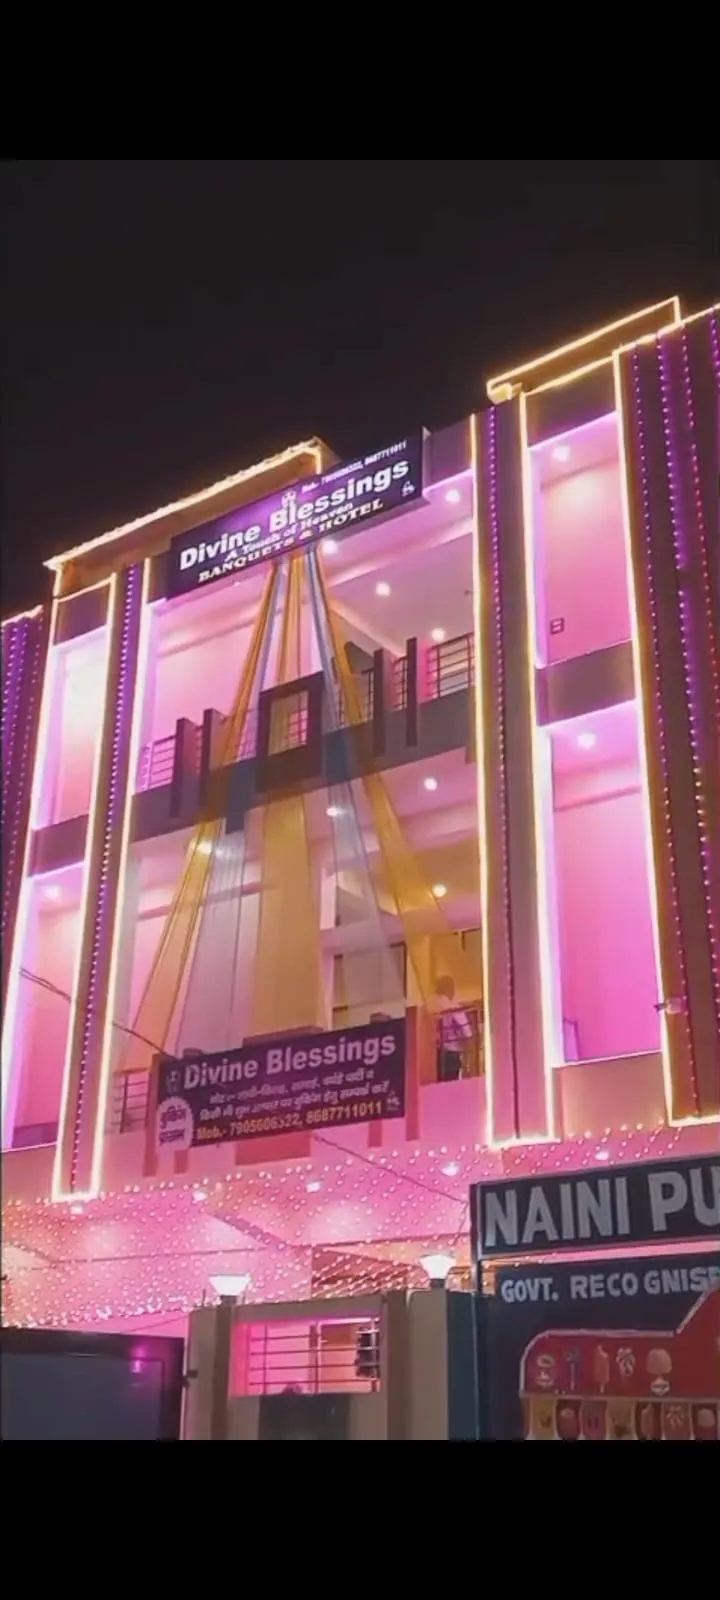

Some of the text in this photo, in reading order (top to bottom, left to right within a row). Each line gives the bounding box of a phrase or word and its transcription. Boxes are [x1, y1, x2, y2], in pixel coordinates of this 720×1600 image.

[179, 524, 261, 570] Divine
[269, 459, 409, 532] Blessings
[198, 538, 295, 582] BANQUETS
[318, 498, 384, 533] HOTEL
[224, 503, 354, 561] A Touch of Heaven
[184, 1035, 396, 1090] Divine Blessings
[306, 1100, 382, 1125] 8687711011
[485, 1164, 720, 1248] NAINI PU
[500, 1276, 559, 1303] GOVT.
